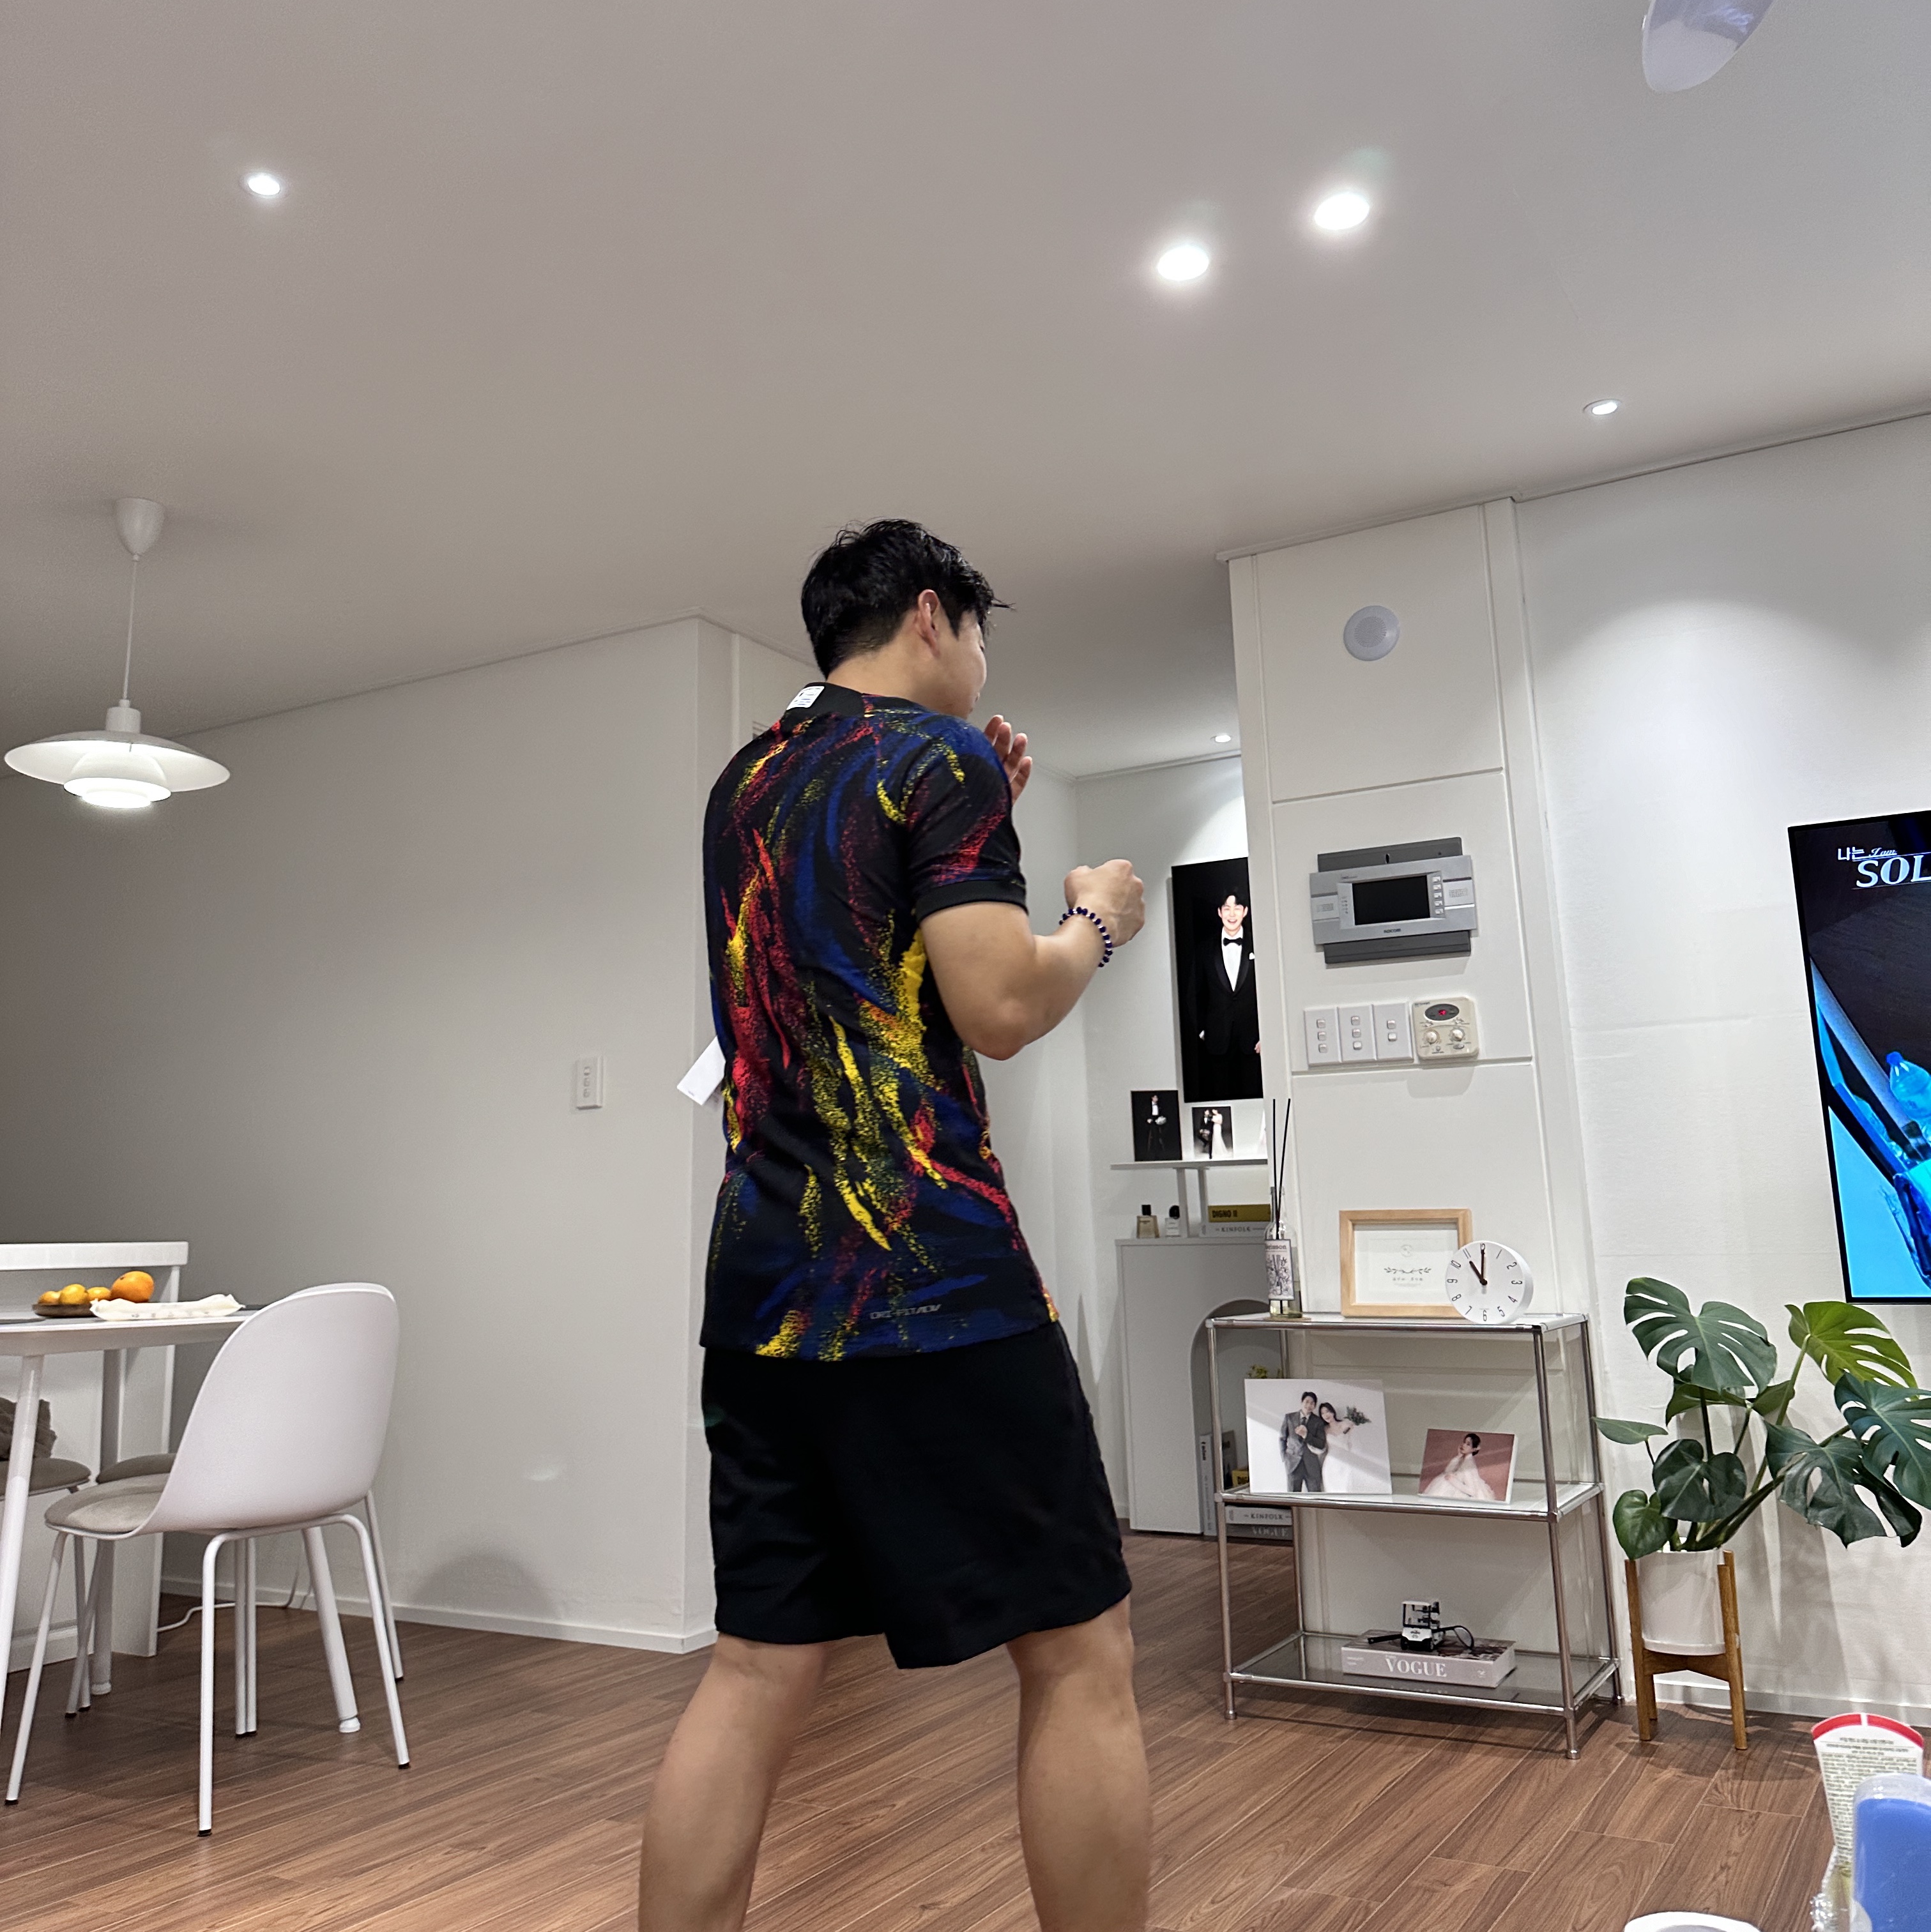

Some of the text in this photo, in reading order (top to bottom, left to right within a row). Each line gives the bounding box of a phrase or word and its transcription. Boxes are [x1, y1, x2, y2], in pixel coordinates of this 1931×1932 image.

[1838, 847, 1865, 860] 나는
[1507, 1261, 1517, 1270] 2
[1465, 1305, 1472, 1315] 7
[1483, 1309, 1487, 1321] 6
[1497, 1306, 1505, 1317] 5
[1385, 1658, 1447, 1677] VOGUE
